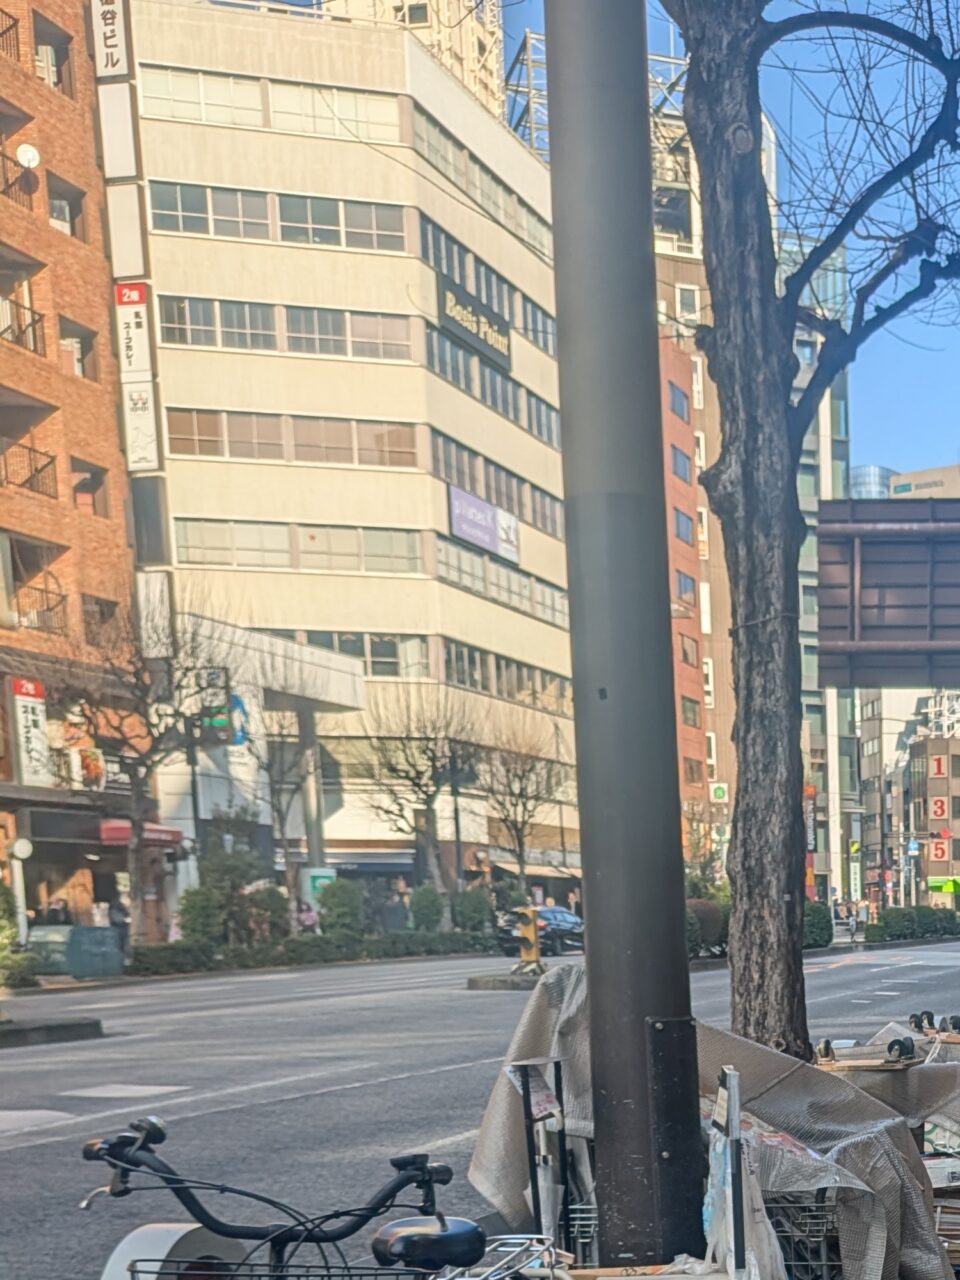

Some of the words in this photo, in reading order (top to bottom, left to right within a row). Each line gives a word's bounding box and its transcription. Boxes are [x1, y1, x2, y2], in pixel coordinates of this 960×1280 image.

[123, 322, 133, 366] スープカレー
[933, 757, 945, 776] 1
[933, 799, 946, 818] 3
[934, 841, 946, 859] 5
